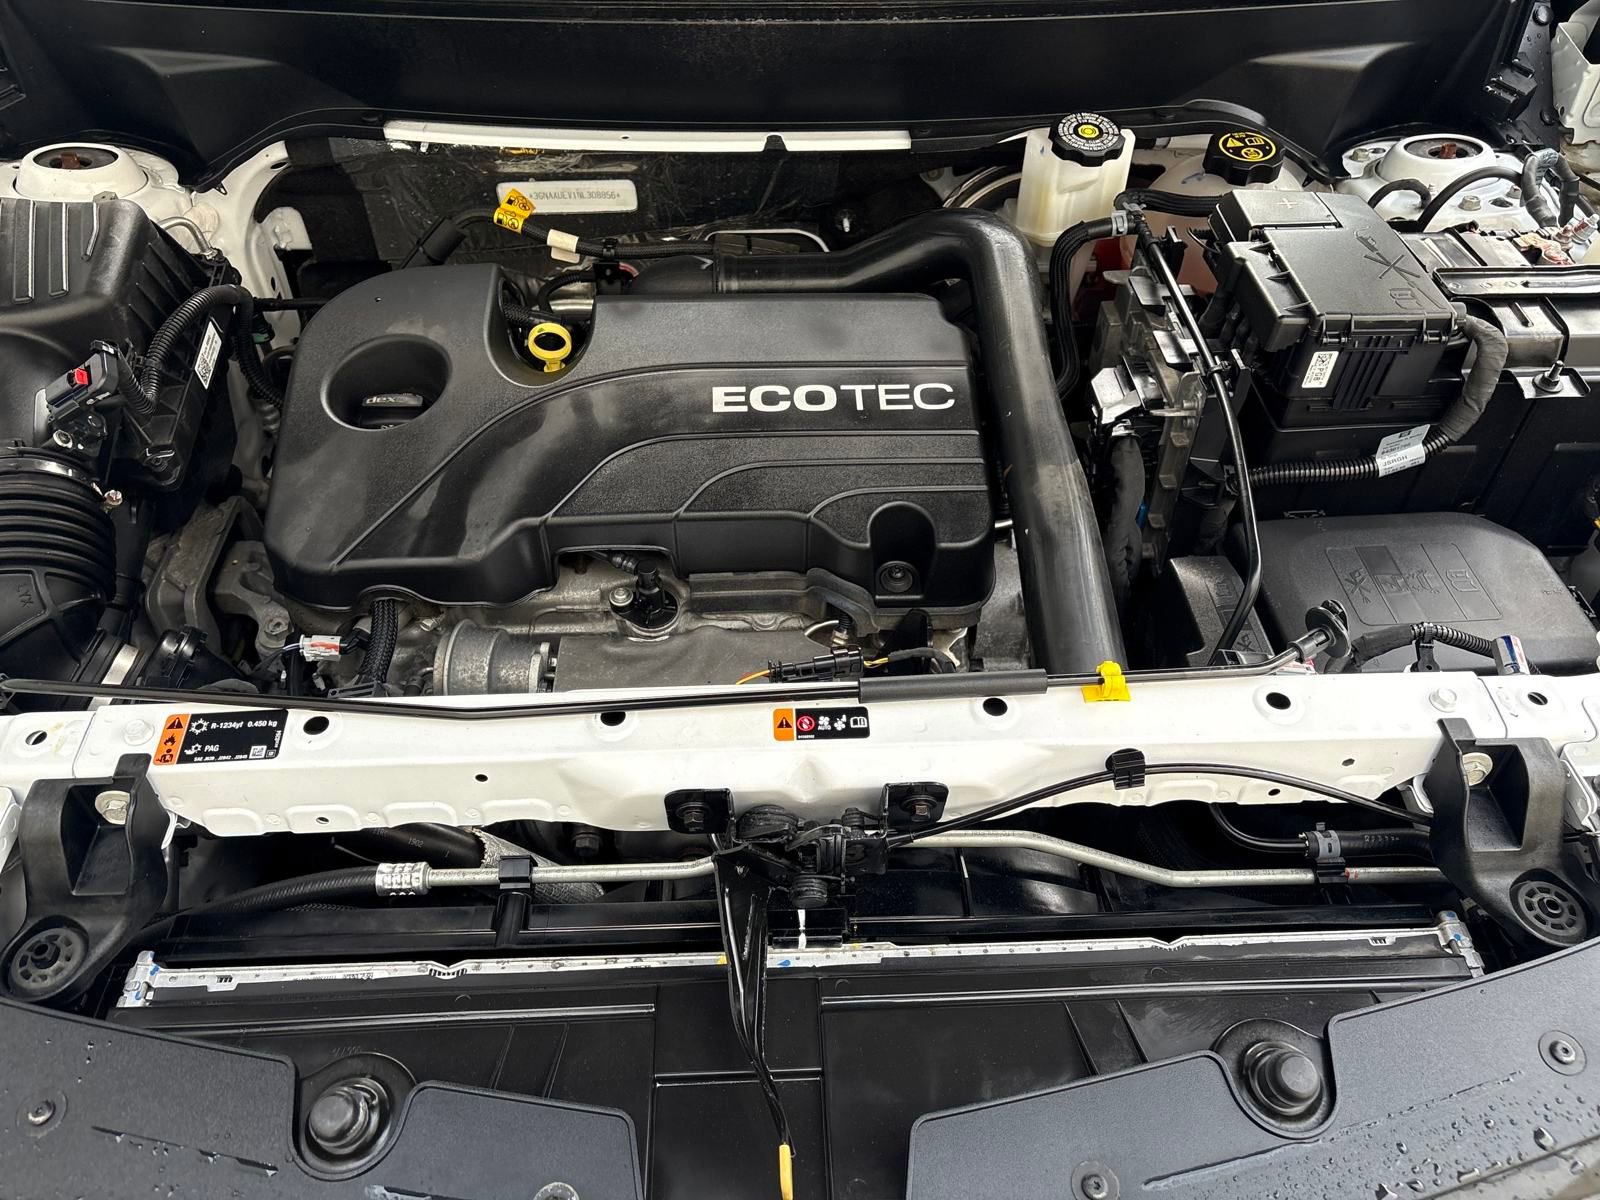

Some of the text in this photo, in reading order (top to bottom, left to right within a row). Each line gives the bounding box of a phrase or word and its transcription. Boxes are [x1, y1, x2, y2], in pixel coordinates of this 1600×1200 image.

[712, 383, 955, 412] ECOTEC
[210, 720, 278, 730] R-1234yf 0.450 kg
[204, 744, 220, 752] PAG
